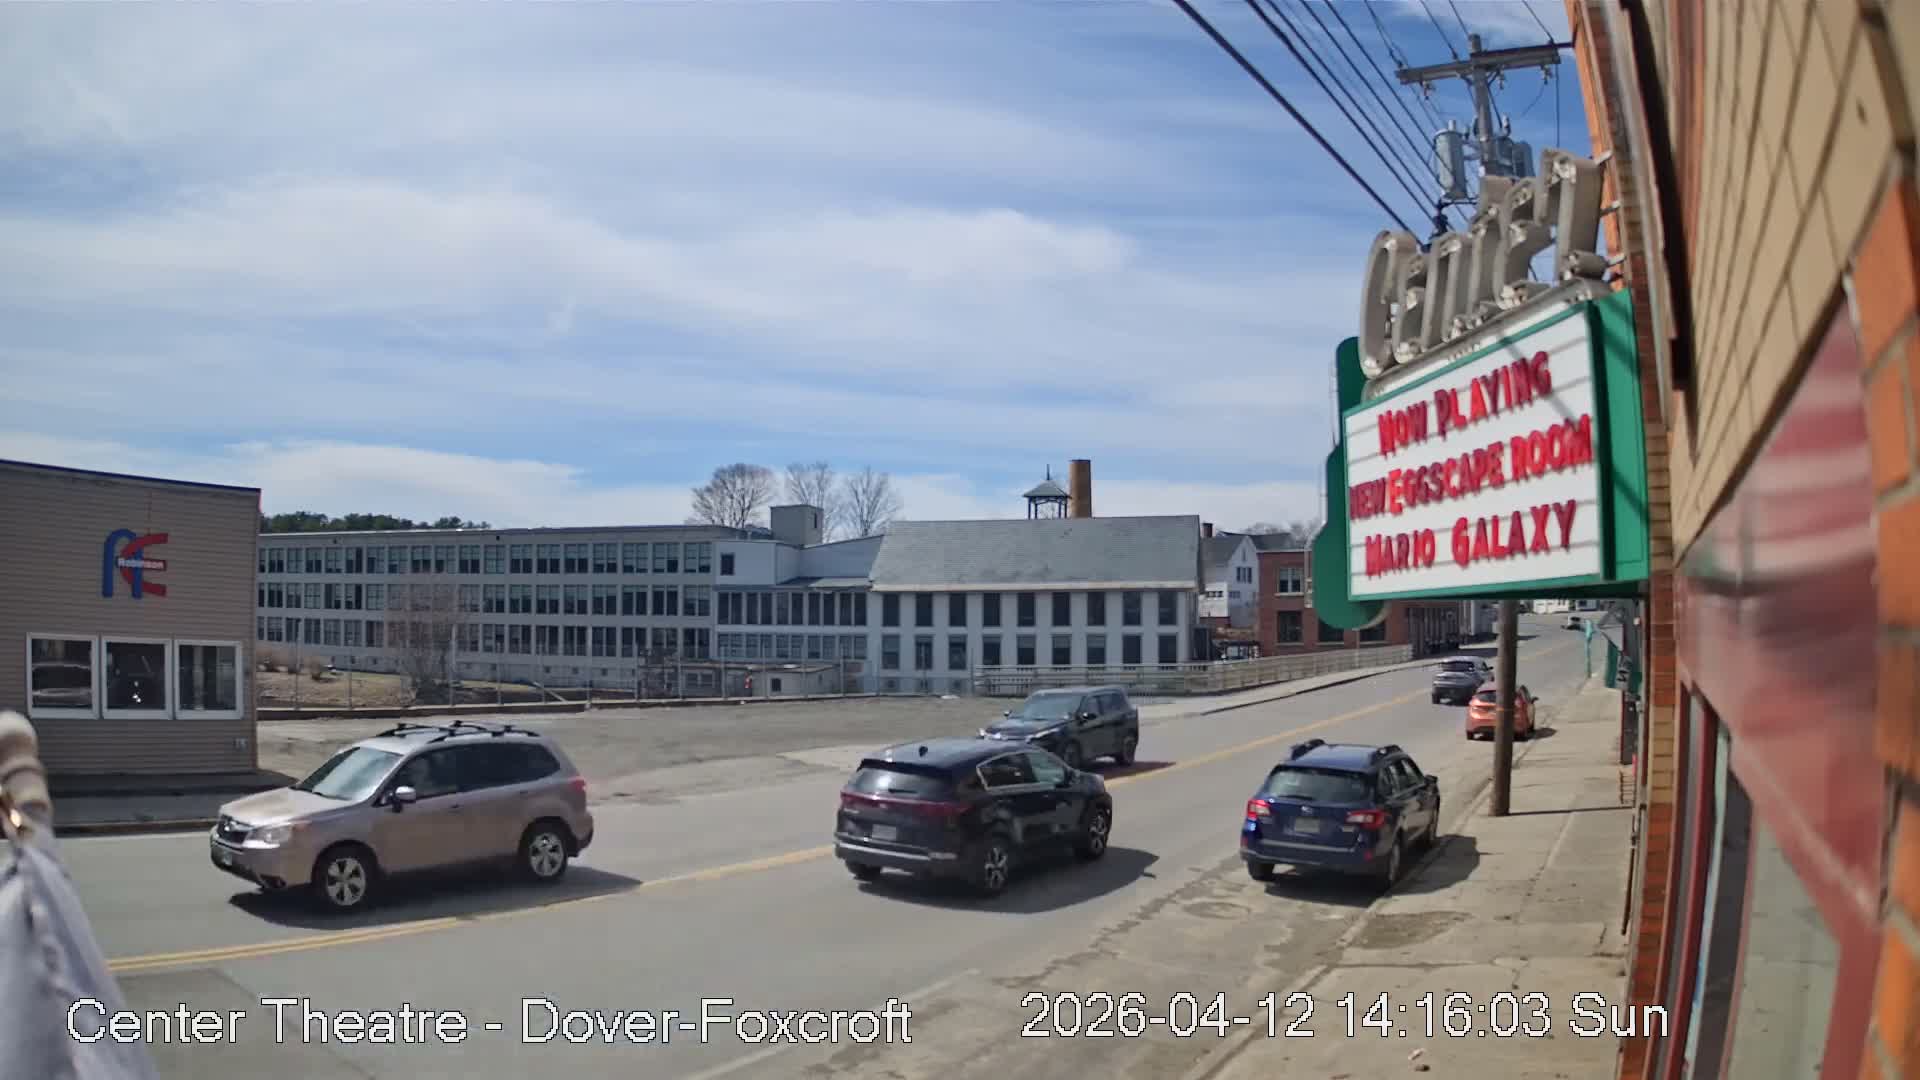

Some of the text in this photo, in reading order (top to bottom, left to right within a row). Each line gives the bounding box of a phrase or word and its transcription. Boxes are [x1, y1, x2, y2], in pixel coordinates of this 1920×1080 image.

[1434, 351, 1552, 440] PLAYING
[1387, 441, 1505, 515] EGGSCAPE
[1510, 413, 1592, 484] ROOM
[1365, 499, 1577, 578] MARIO GALAXY
